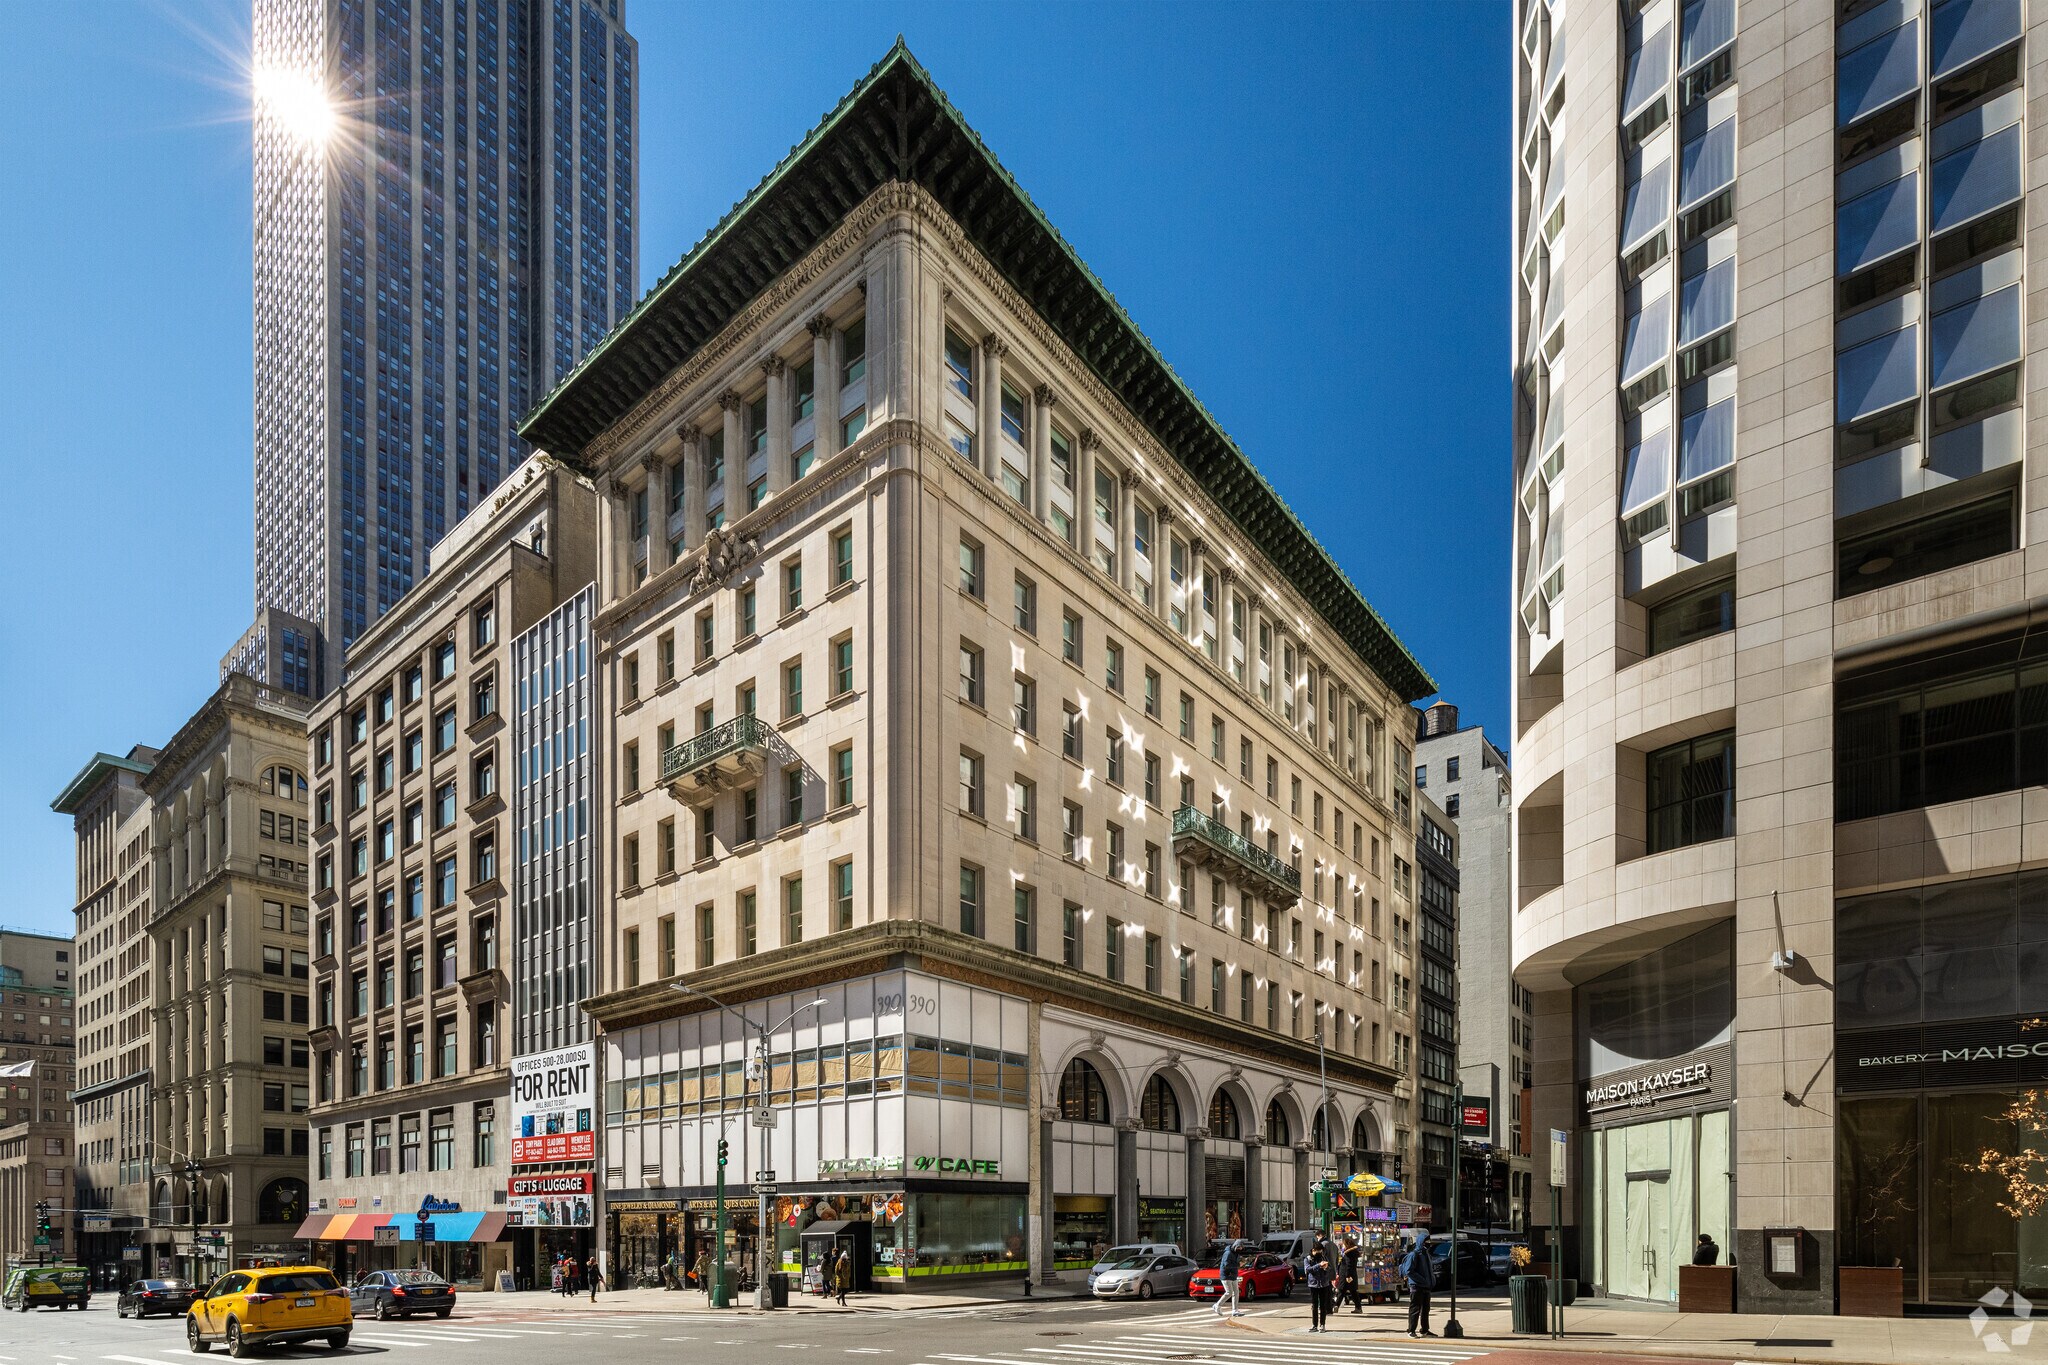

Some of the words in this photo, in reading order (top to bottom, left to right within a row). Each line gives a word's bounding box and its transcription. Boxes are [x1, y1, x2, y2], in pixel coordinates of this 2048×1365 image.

[909, 994, 936, 1016] 390
[517, 1058, 542, 1072] OFFICES
[1858, 1053, 1929, 1067] BAKERY
[514, 1073, 544, 1103] FOR
[547, 1063, 590, 1099] RENT
[1586, 1079, 1638, 1104] MAISON
[1643, 1063, 1708, 1091] KAYSER
[1630, 1095, 1651, 1107] PARIS
[938, 1158, 999, 1173] CAFE
[513, 1180, 537, 1193] GIFTS
[543, 1177, 582, 1192] LUGGAGE
[648, 1201, 676, 1209] DIAMONDS
[689, 1200, 703, 1209] ARTS
[704, 1200, 709, 1208] &
[709, 1199, 738, 1210] ANQUES
[740, 1199, 760, 1208] CENTE
